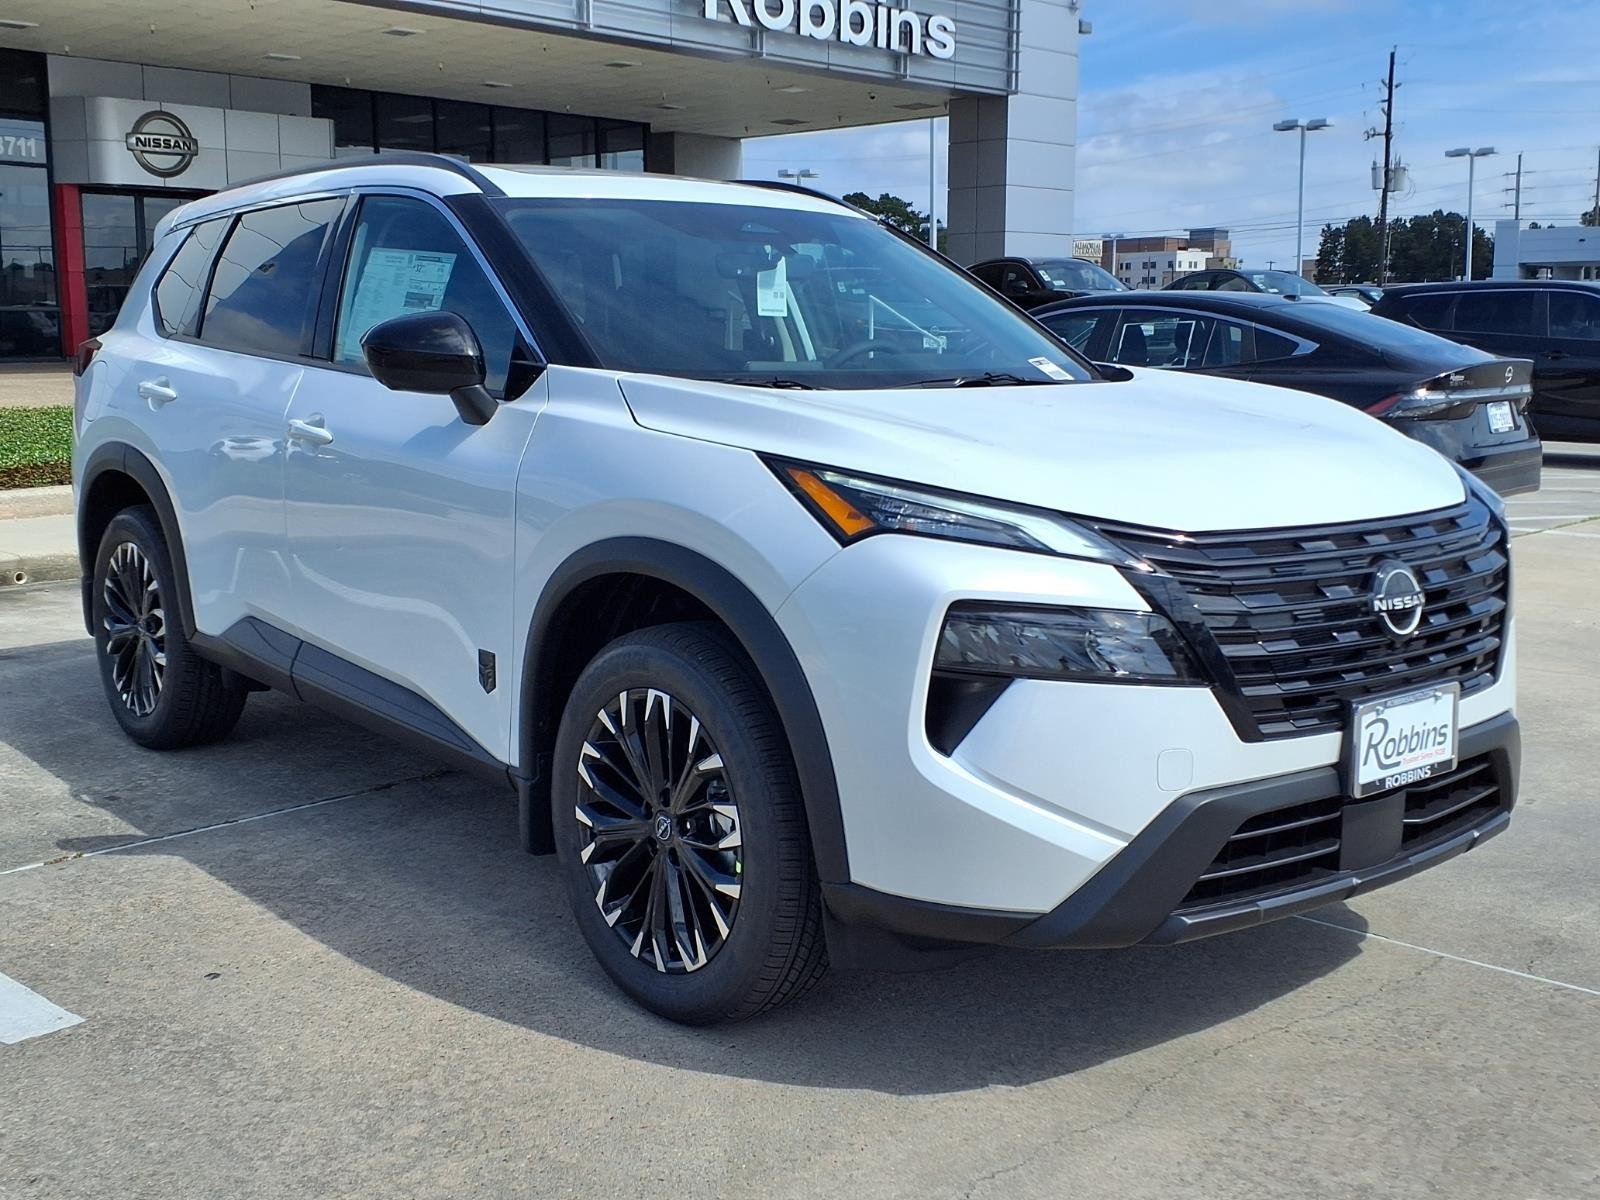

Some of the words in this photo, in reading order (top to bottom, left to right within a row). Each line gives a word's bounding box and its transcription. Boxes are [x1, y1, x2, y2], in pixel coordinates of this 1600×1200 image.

[135, 136, 193, 151] NISSAN
[1373, 593, 1426, 611] NISSAN
[1363, 717, 1449, 771] Robbins
[1385, 766, 1431, 789] ROBBINS
